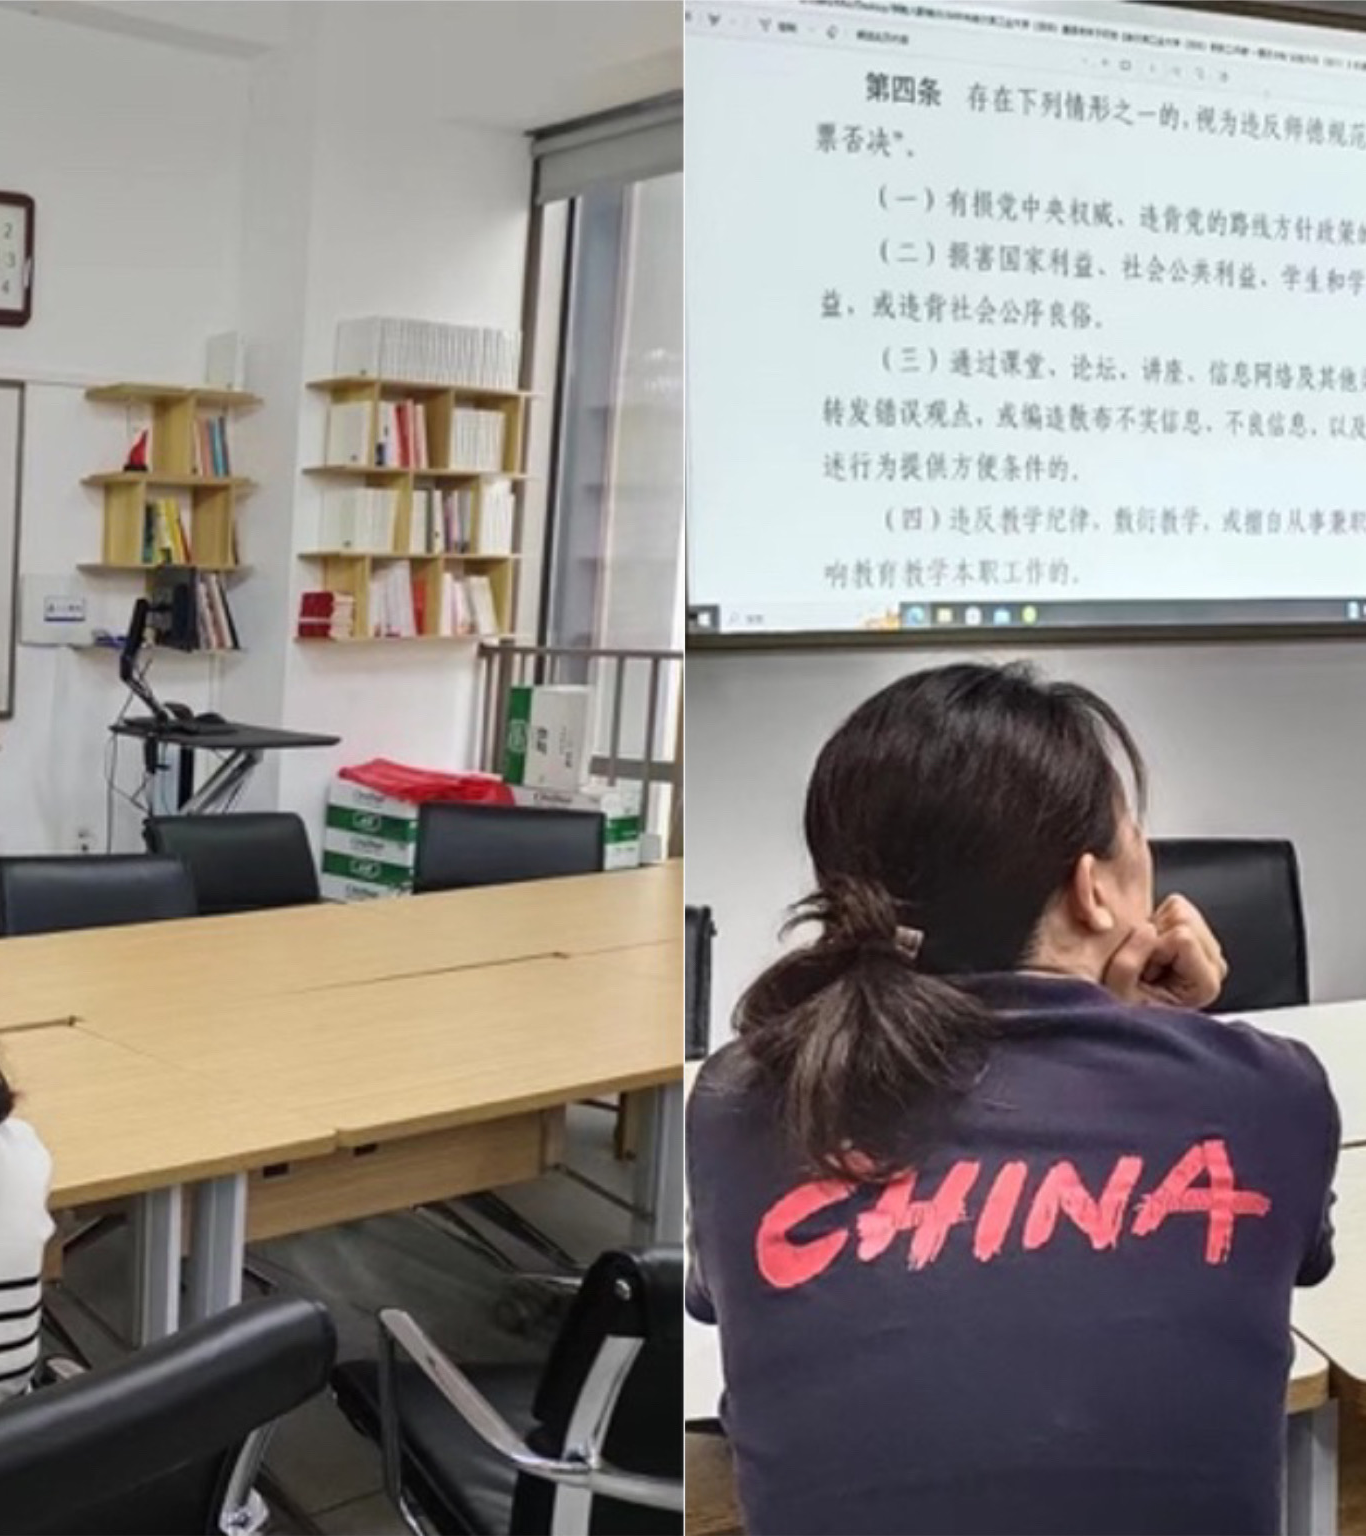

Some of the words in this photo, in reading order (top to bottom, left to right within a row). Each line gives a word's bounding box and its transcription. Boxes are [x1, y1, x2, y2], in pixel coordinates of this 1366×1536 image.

[863, 71, 943, 107] 第四条
[755, 1138, 1271, 1288] CHINA
